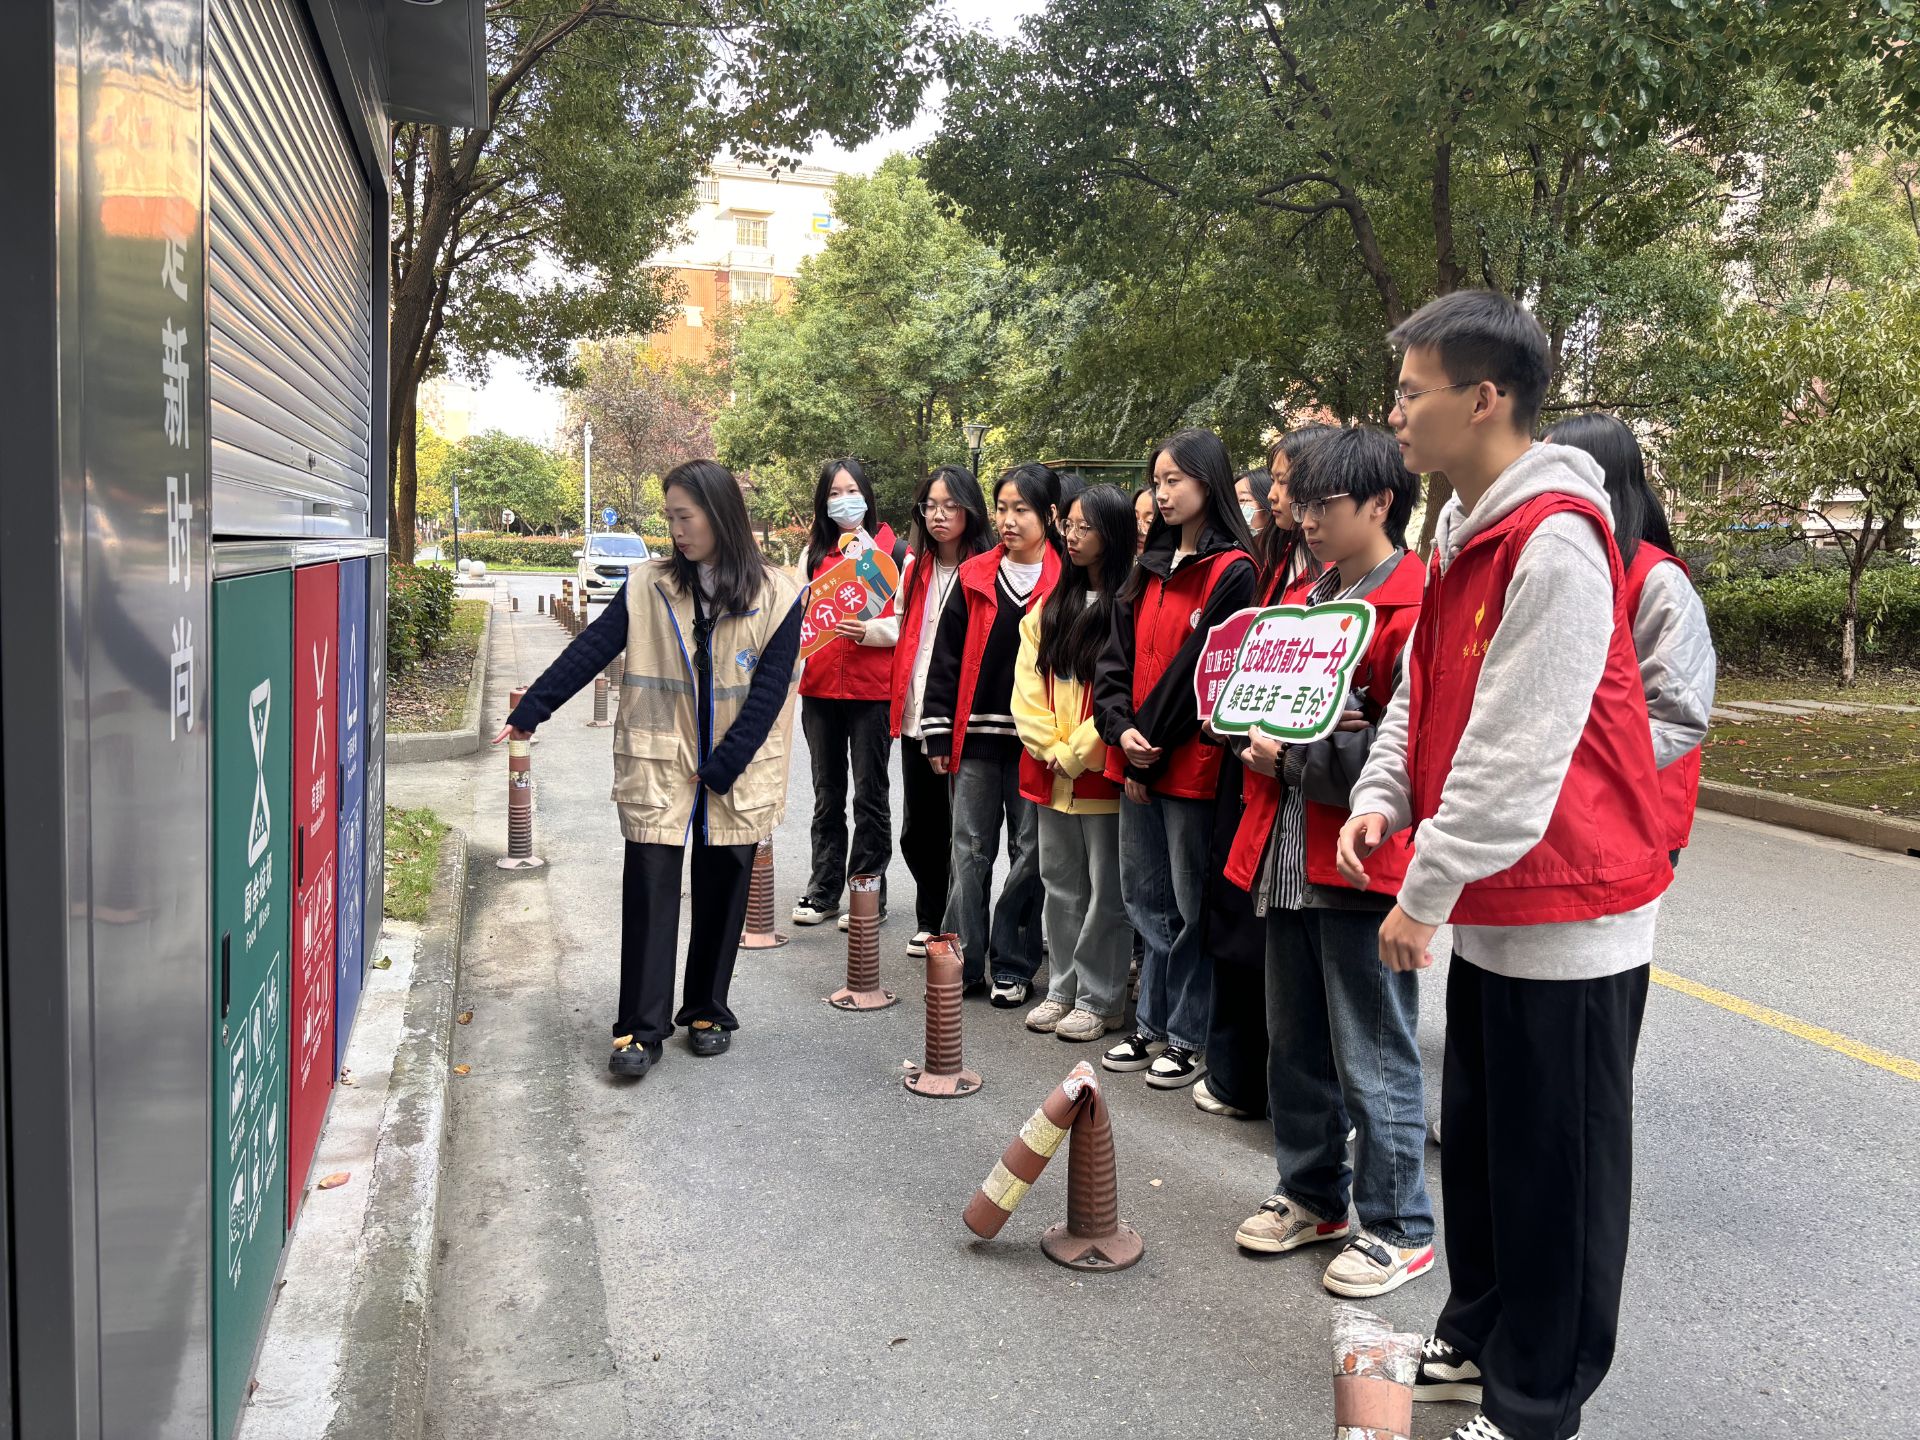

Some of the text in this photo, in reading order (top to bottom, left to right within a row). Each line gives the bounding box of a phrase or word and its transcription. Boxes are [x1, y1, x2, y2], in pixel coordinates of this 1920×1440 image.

[1241, 637, 1347, 675] 垃圾扔前分一分
[1227, 684, 1324, 715] 绿色生活一百分
